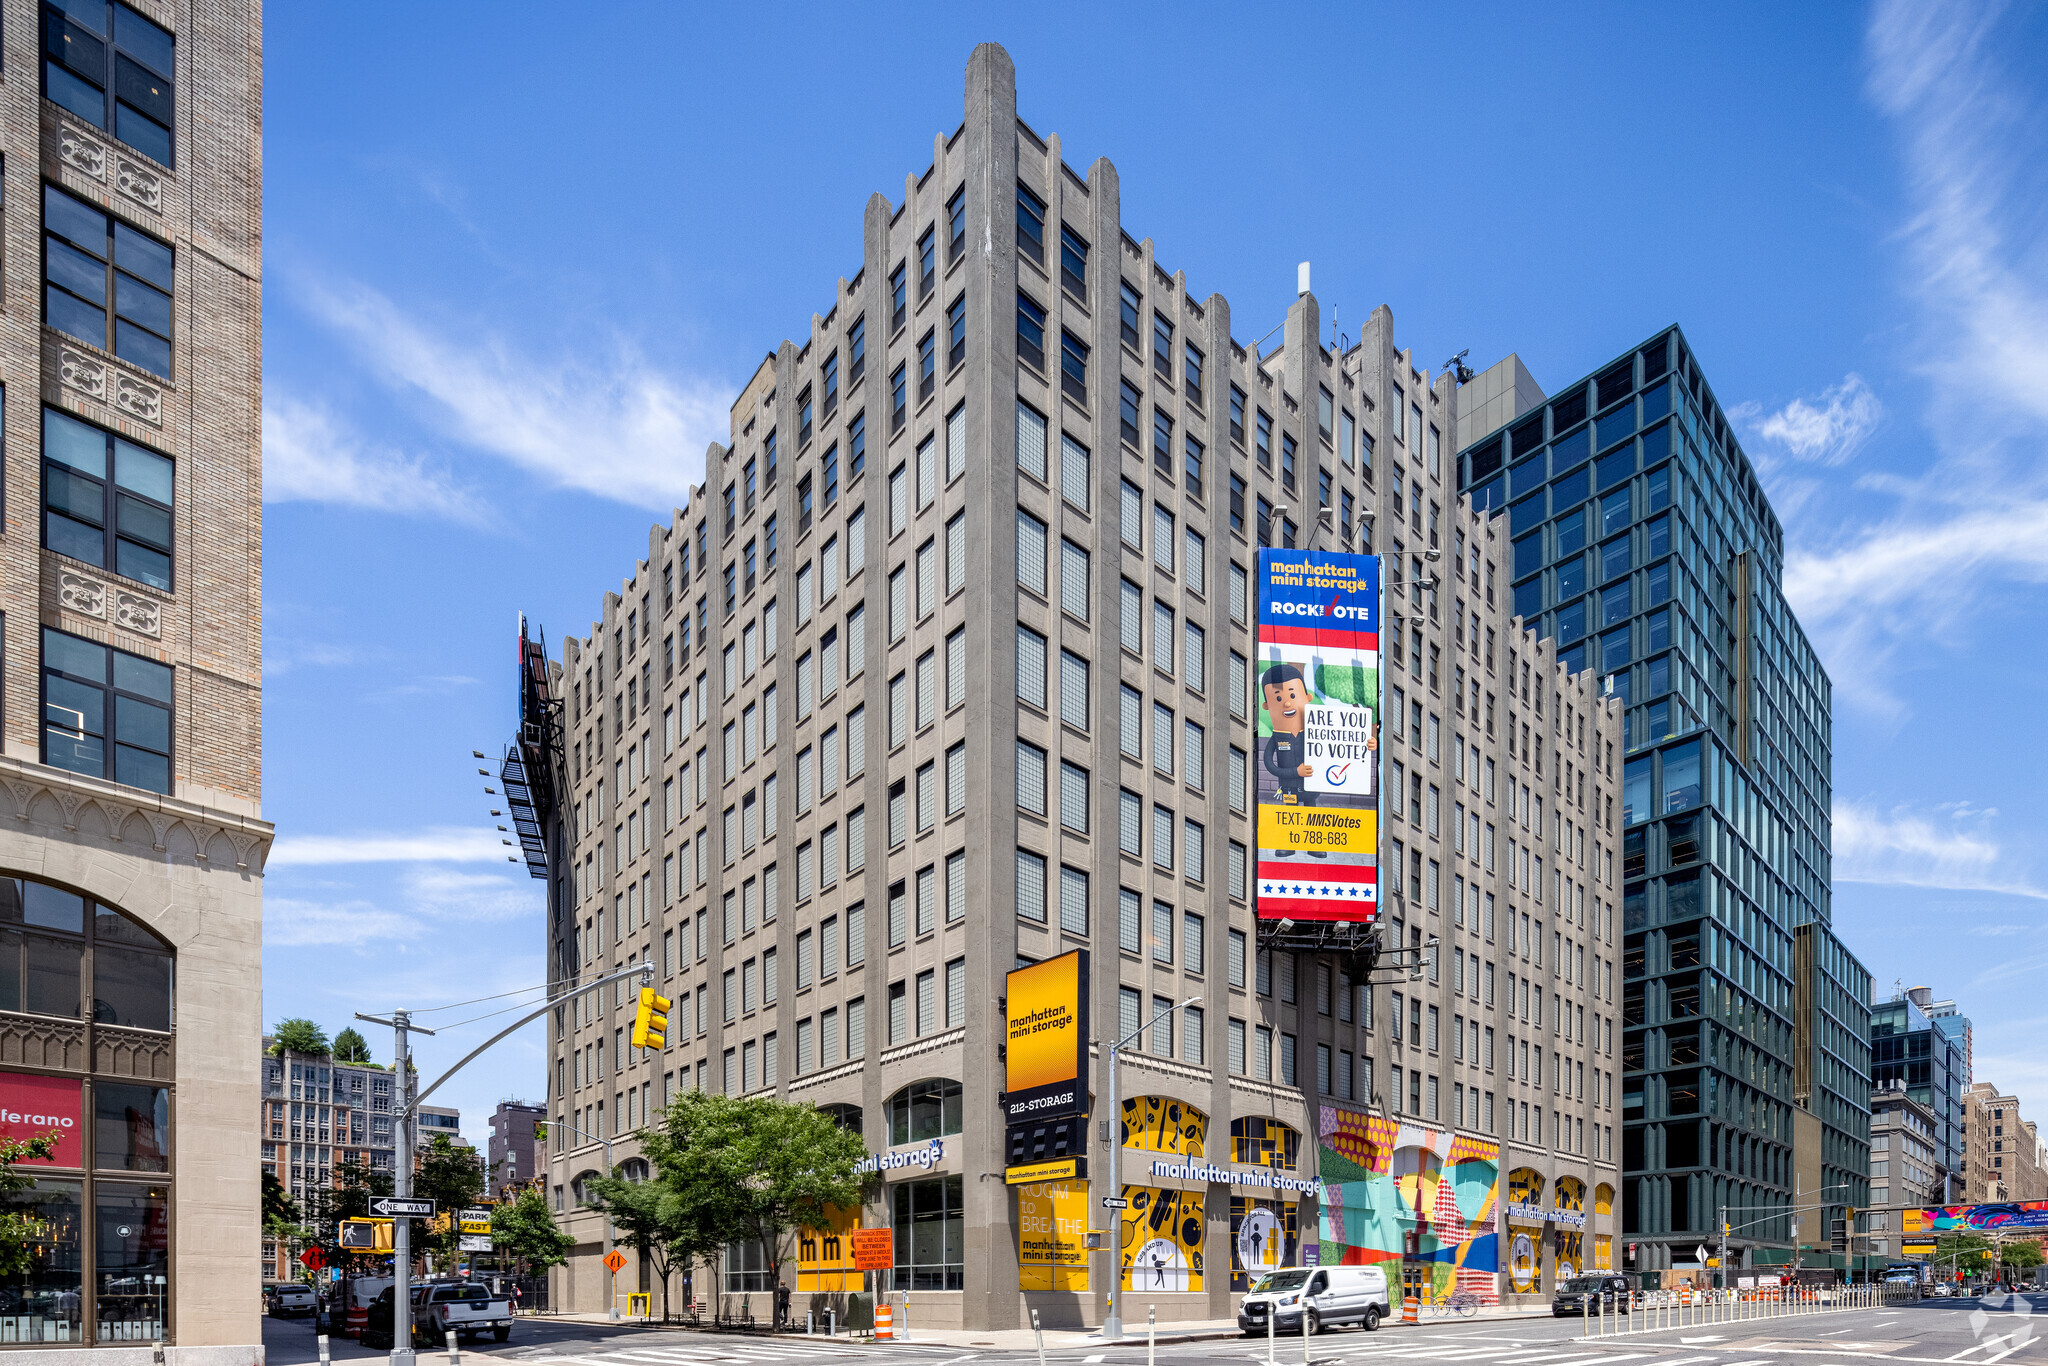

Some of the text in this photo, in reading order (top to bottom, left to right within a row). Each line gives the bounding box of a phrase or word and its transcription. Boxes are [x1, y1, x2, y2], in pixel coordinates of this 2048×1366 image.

[1270, 557, 1357, 577] manhattan
[1270, 573, 1367, 593] mini storage
[1271, 601, 1320, 617] ROCK
[1307, 710, 1367, 728] ARE YOU
[1307, 728, 1367, 743] REGISTERED
[1306, 742, 1323, 757] TO
[1328, 743, 1368, 763] VOTE?
[1275, 811, 1362, 829] TEXT: MMSVotes
[1289, 830, 1348, 846] to 788-683
[1010, 1008, 1066, 1029] manhattan
[1010, 1014, 1073, 1040] mini storage
[1010, 1092, 1074, 1114] 212-STORAGE
[881, 1143, 944, 1170] storage
[1008, 1166, 1071, 1180] manhattan mini storage
[1152, 1152, 1321, 1198] manhattan mini storage
[1020, 1181, 1069, 1200] ROOM
[379, 1202, 427, 1212] ONE WAY
[1021, 1200, 1037, 1214] to
[1508, 1200, 1548, 1221] manhattan
[1562, 1213, 1587, 1229] storage
[462, 1222, 488, 1231] FAST
[1021, 1215, 1083, 1235] BREATHE
[1022, 1237, 1075, 1251] manhattan
[1022, 1250, 1081, 1263] mini storage
